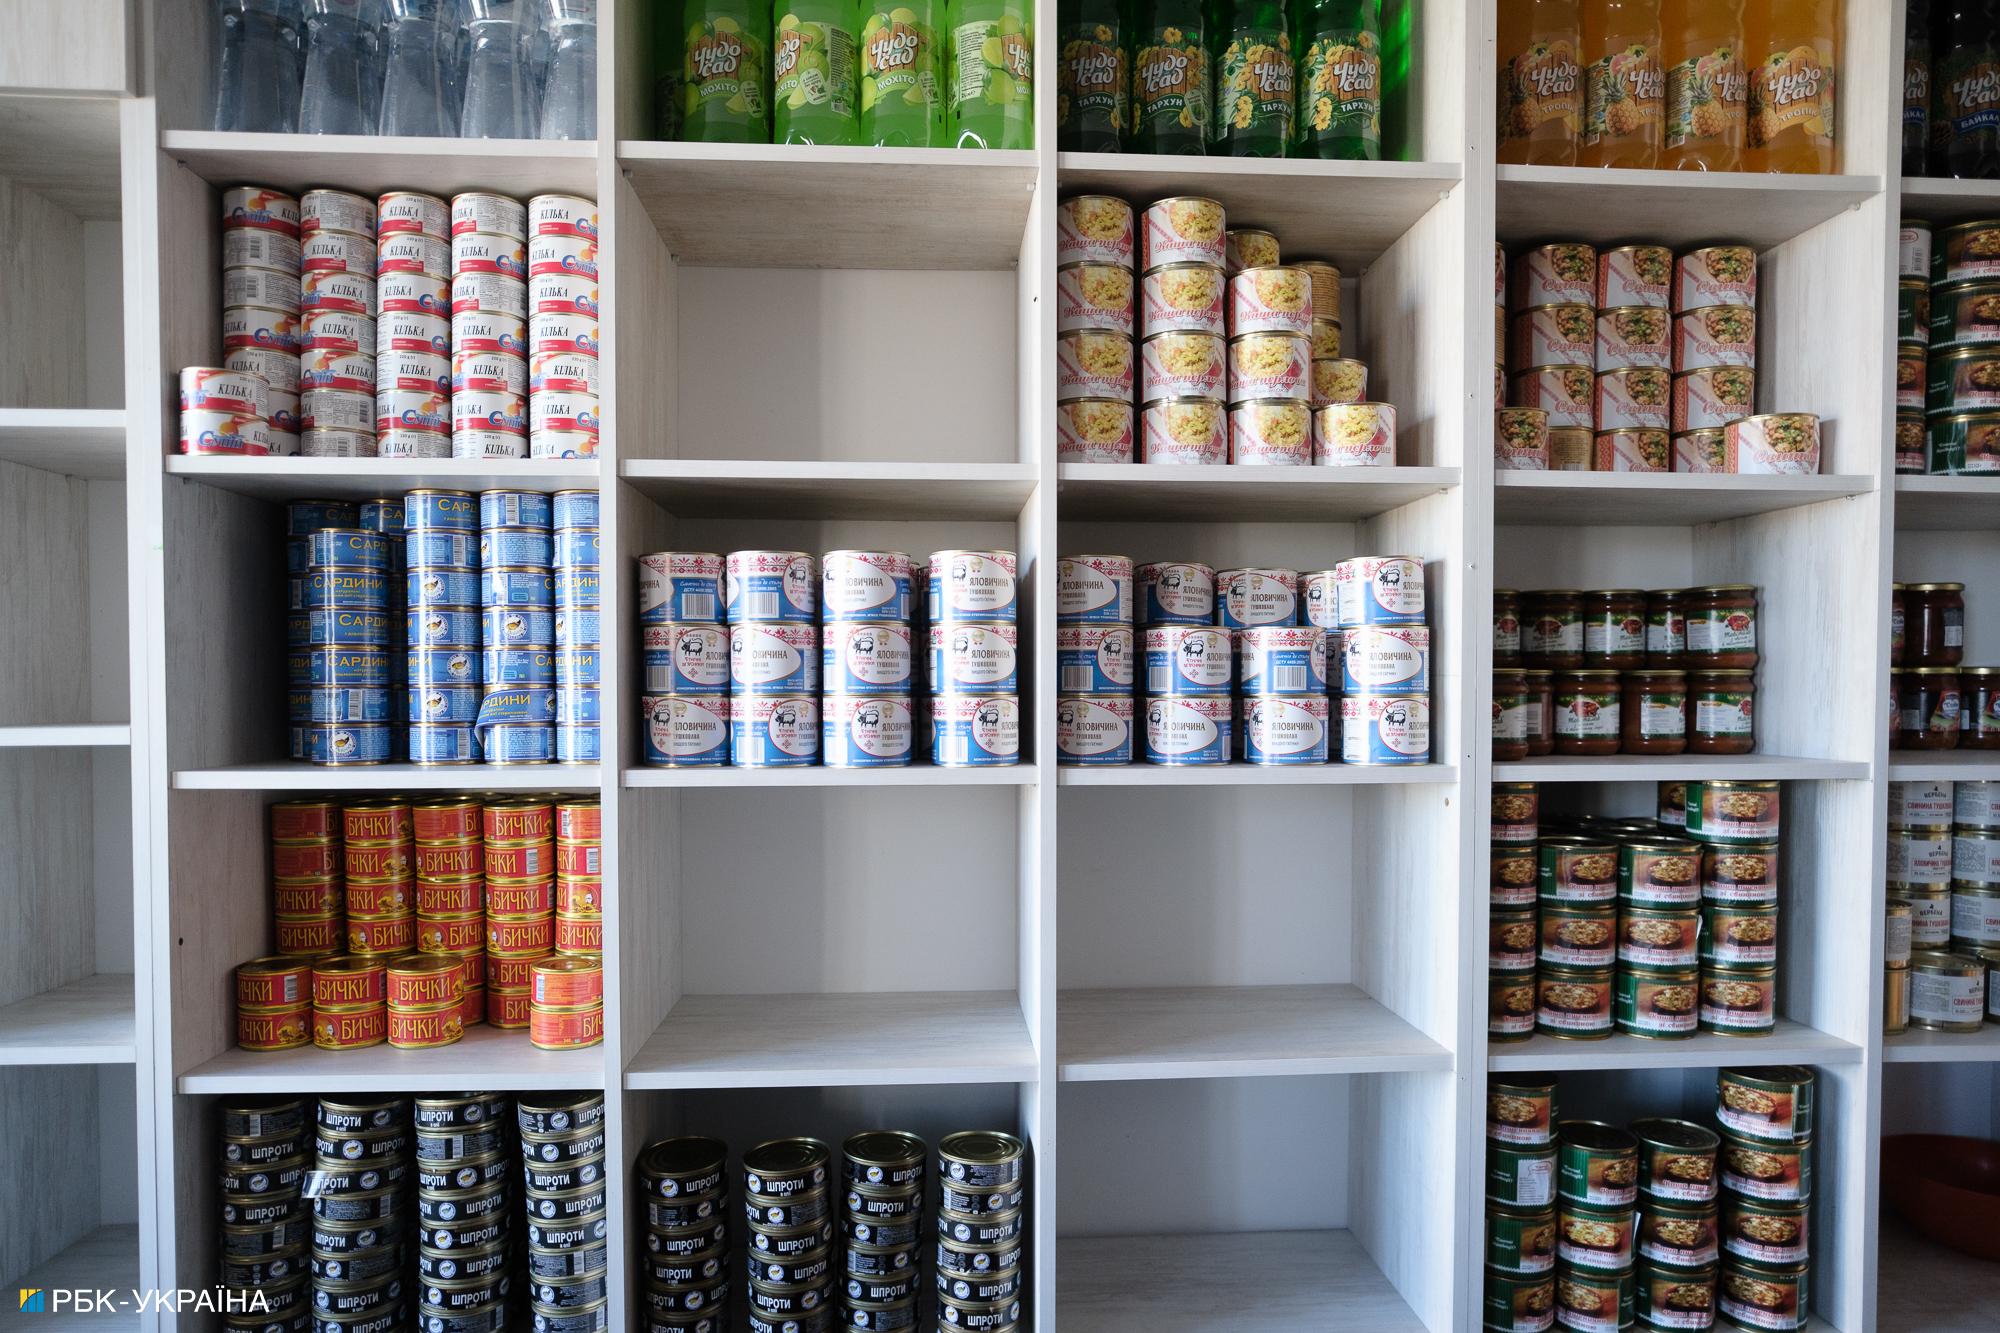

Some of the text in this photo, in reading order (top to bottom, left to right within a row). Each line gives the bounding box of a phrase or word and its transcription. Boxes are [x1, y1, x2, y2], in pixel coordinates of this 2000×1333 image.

[1079, 96, 1114, 108] ТАРХУН
[1146, 98, 1183, 114] ТАРХУН
[389, 206, 419, 217] КІЛЬКА
[541, 208, 568, 219] КІЛЬКА
[312, 244, 342, 256] КІЛЬКА
[390, 246, 420, 256] КІЛЬКА
[462, 245, 489, 257] КІЛЬКА
[331, 284, 363, 298] КІЛЬКА
[540, 286, 568, 297] КІЛЬКА
[322, 322, 354, 337] КІЛЬКА
[394, 325, 424, 337] КІЛЬКА
[462, 325, 492, 336] КІЛЬКА
[541, 326, 569, 337] КІЛЬКА
[400, 364, 431, 377] КІЛЬКА
[473, 364, 504, 377] КІЛЬКА
[554, 364, 584, 377] КІЛЬКА
[218, 384, 252, 400] КІЛЬКА
[484, 443, 515, 456] КІЛЬКА
[1076, 722, 1119, 732] ЯЛОВИЧИНА
[348, 816, 394, 836] БИЧКИ
[496, 814, 542, 836] БИЧКИ
[346, 854, 379, 874] ИЧКИ
[426, 850, 474, 872] БИЧКИ
[486, 854, 516, 873] ИЧКИ
[424, 889, 470, 909] БИЧКИ
[494, 888, 540, 910] БИЧКИ
[282, 927, 330, 948] БИЧКИ
[503, 925, 549, 947] БИЧКИ
[320, 979, 370, 1001] БИЧКИ
[400, 977, 450, 1001] БИЧКИ
[392, 1018, 440, 1041] БИЧКИ
[326, 1112, 362, 1127] ШПРОТИ
[420, 1110, 454, 1122] ШПРОТИ
[252, 1142, 294, 1160] ШПРОТИ
[570, 1135, 604, 1156] ШПРОТИ
[535, 1174, 570, 1187] ШПРОТИ
[686, 1171, 720, 1193] ШПРОТИ
[766, 1180, 804, 1193] ШПРОТИ
[466, 1194, 502, 1214] ШПРОТИ
[566, 1194, 602, 1213] ШПРОТИ
[868, 1200, 904, 1214] ШПРОТИ
[246, 1204, 288, 1220] ШПРОТИ
[316, 1233, 346, 1248] ШПРОТИ
[460, 1226, 498, 1244] ШПРОТИ
[547, 1230, 584, 1244] ШПРОТИ
[980, 1227, 1013, 1240] ШПРОТИ
[667, 1237, 704, 1252] ШПРОТИ
[778, 1236, 815, 1252] ШПРОТИ
[467, 1254, 502, 1272] ШПРОТИ
[794, 1260, 826, 1280] ШПРОТИ
[656, 1266, 692, 1280] ШПРОТИ
[871, 1284, 906, 1298] ШПРОТИ
[980, 1282, 1012, 1297] ШПРОТИ
[338, 1292, 379, 1309] ШПРОТИ
[452, 1290, 490, 1306] ШПРОТИ
[757, 1294, 791, 1308] ШПРОТИ
[968, 1314, 1004, 1326] ШПРОТИ
